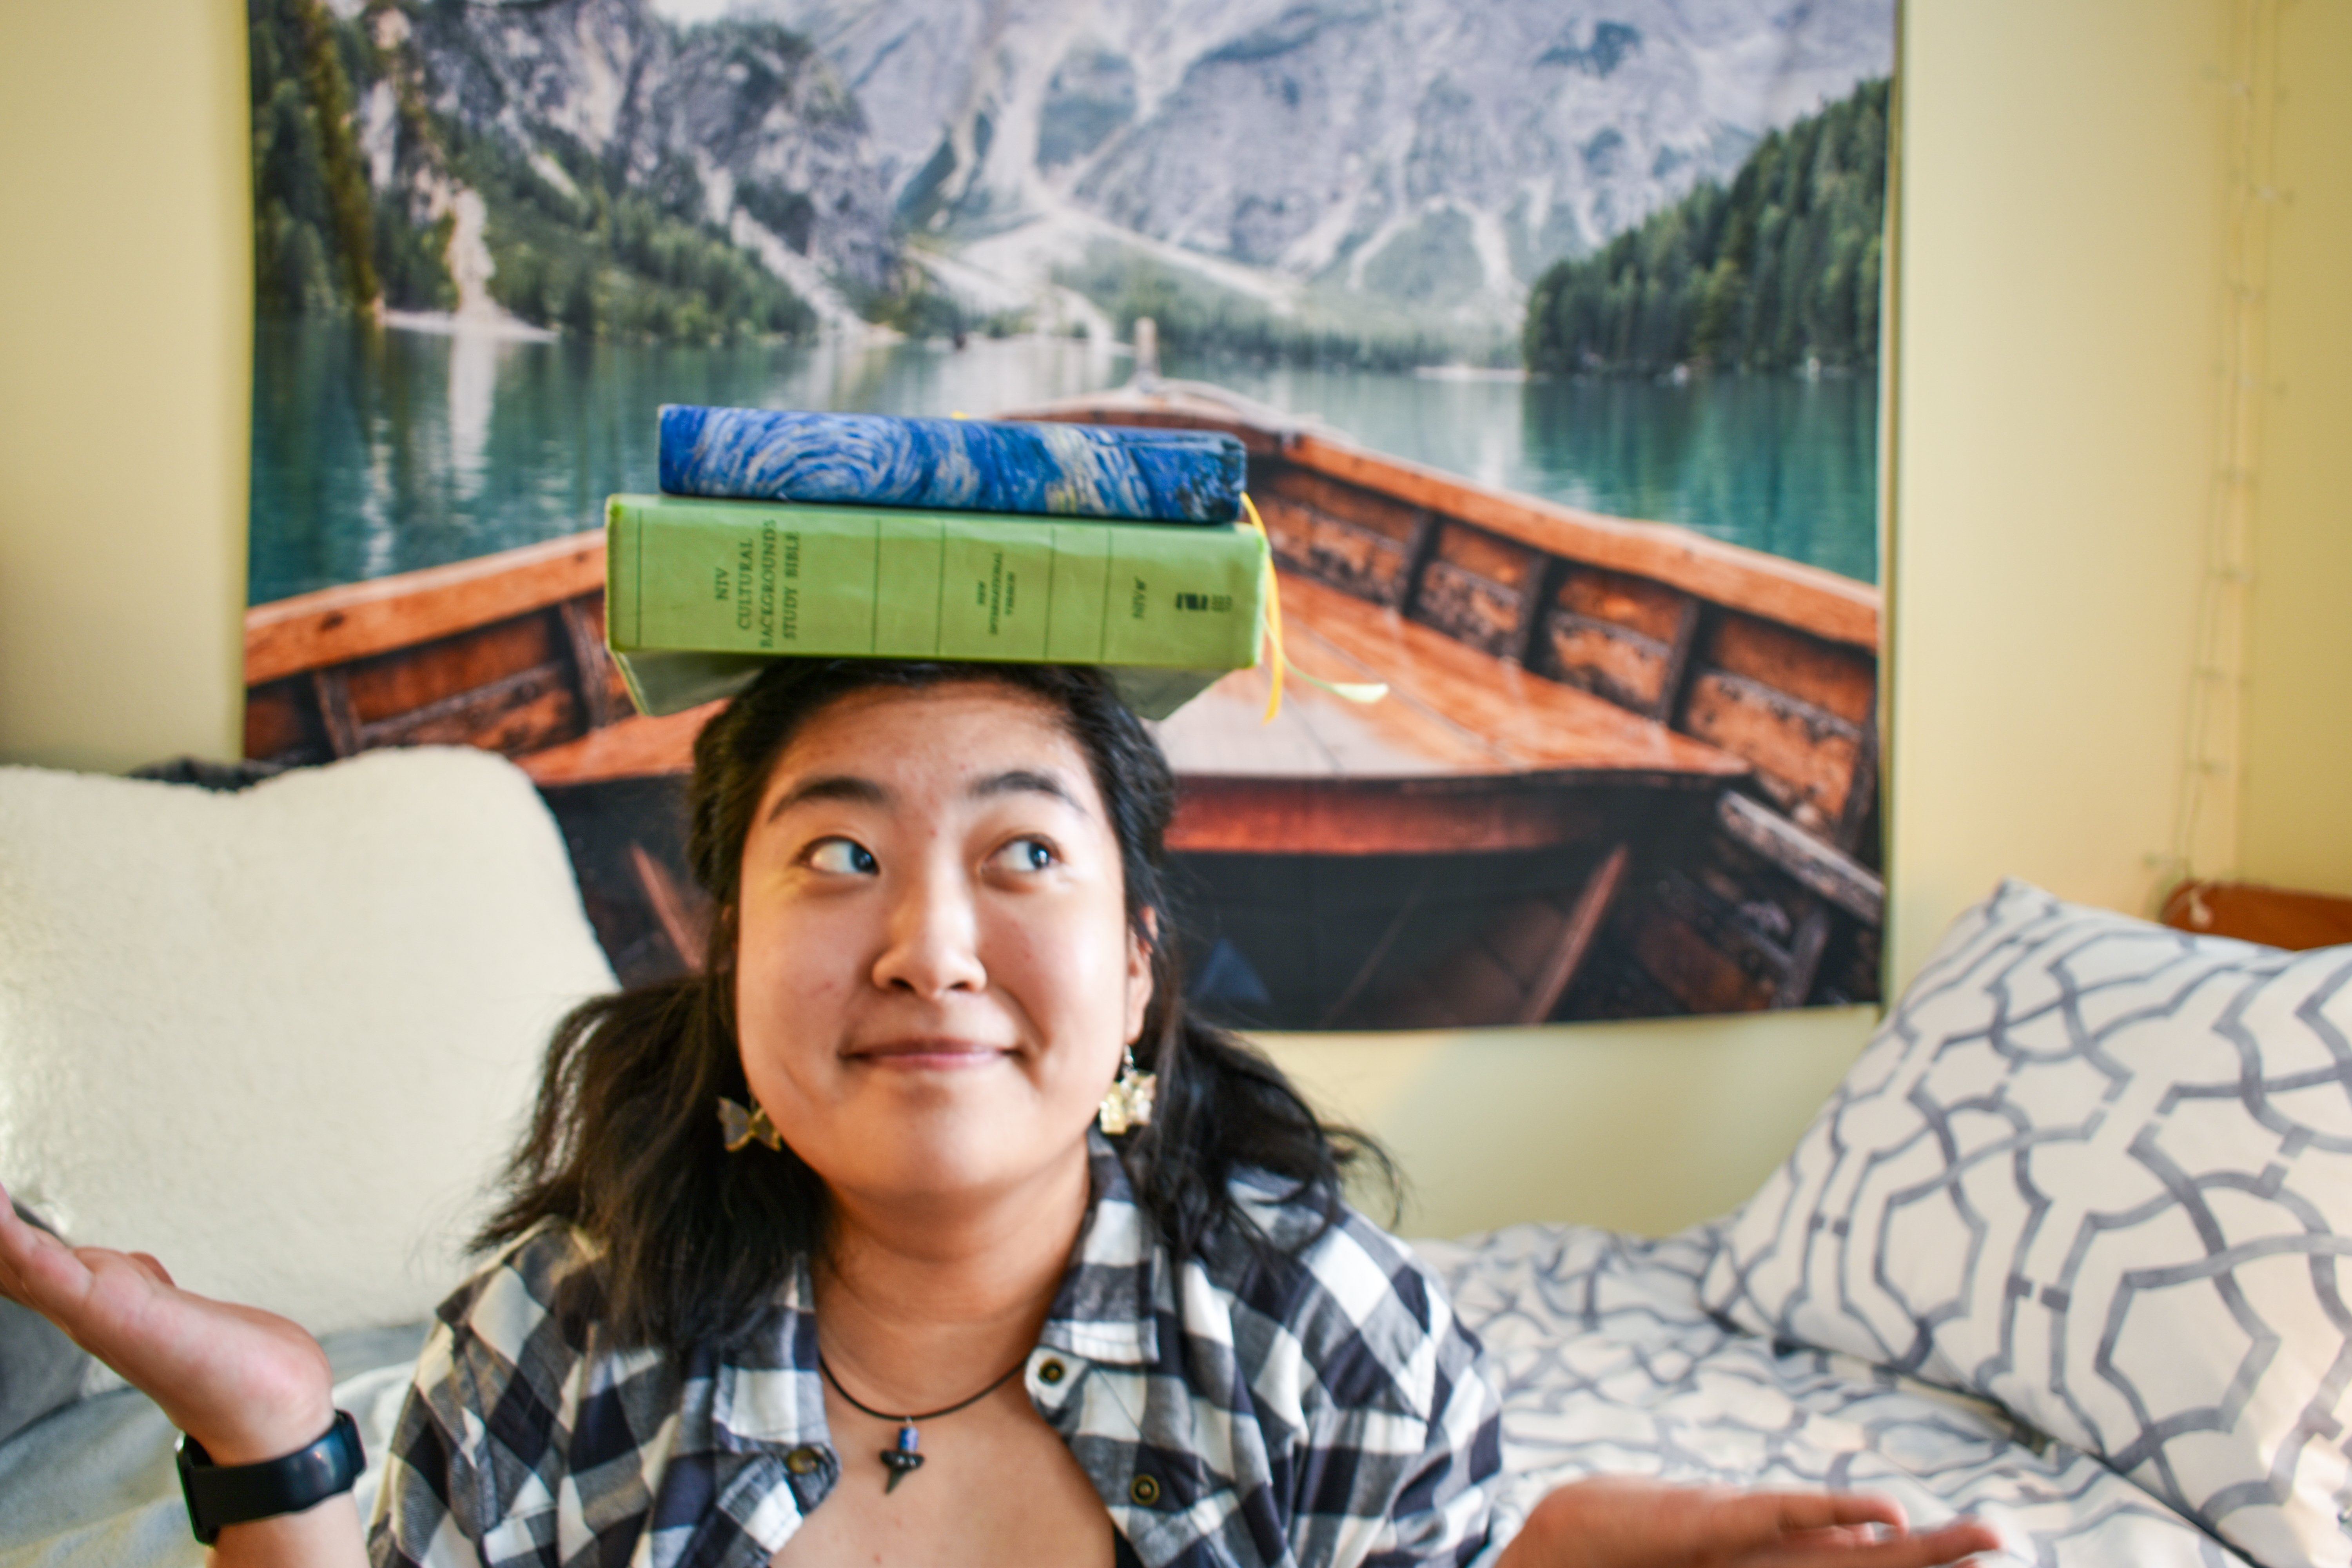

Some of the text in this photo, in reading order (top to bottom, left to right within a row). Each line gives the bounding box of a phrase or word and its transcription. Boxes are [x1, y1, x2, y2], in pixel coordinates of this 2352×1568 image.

[715, 567, 729, 600] NIV
[737, 539, 753, 630] CULTURAL
[760, 520, 776, 648] BACKGROUNDS
[783, 532, 799, 639] STUDY BIBLE
